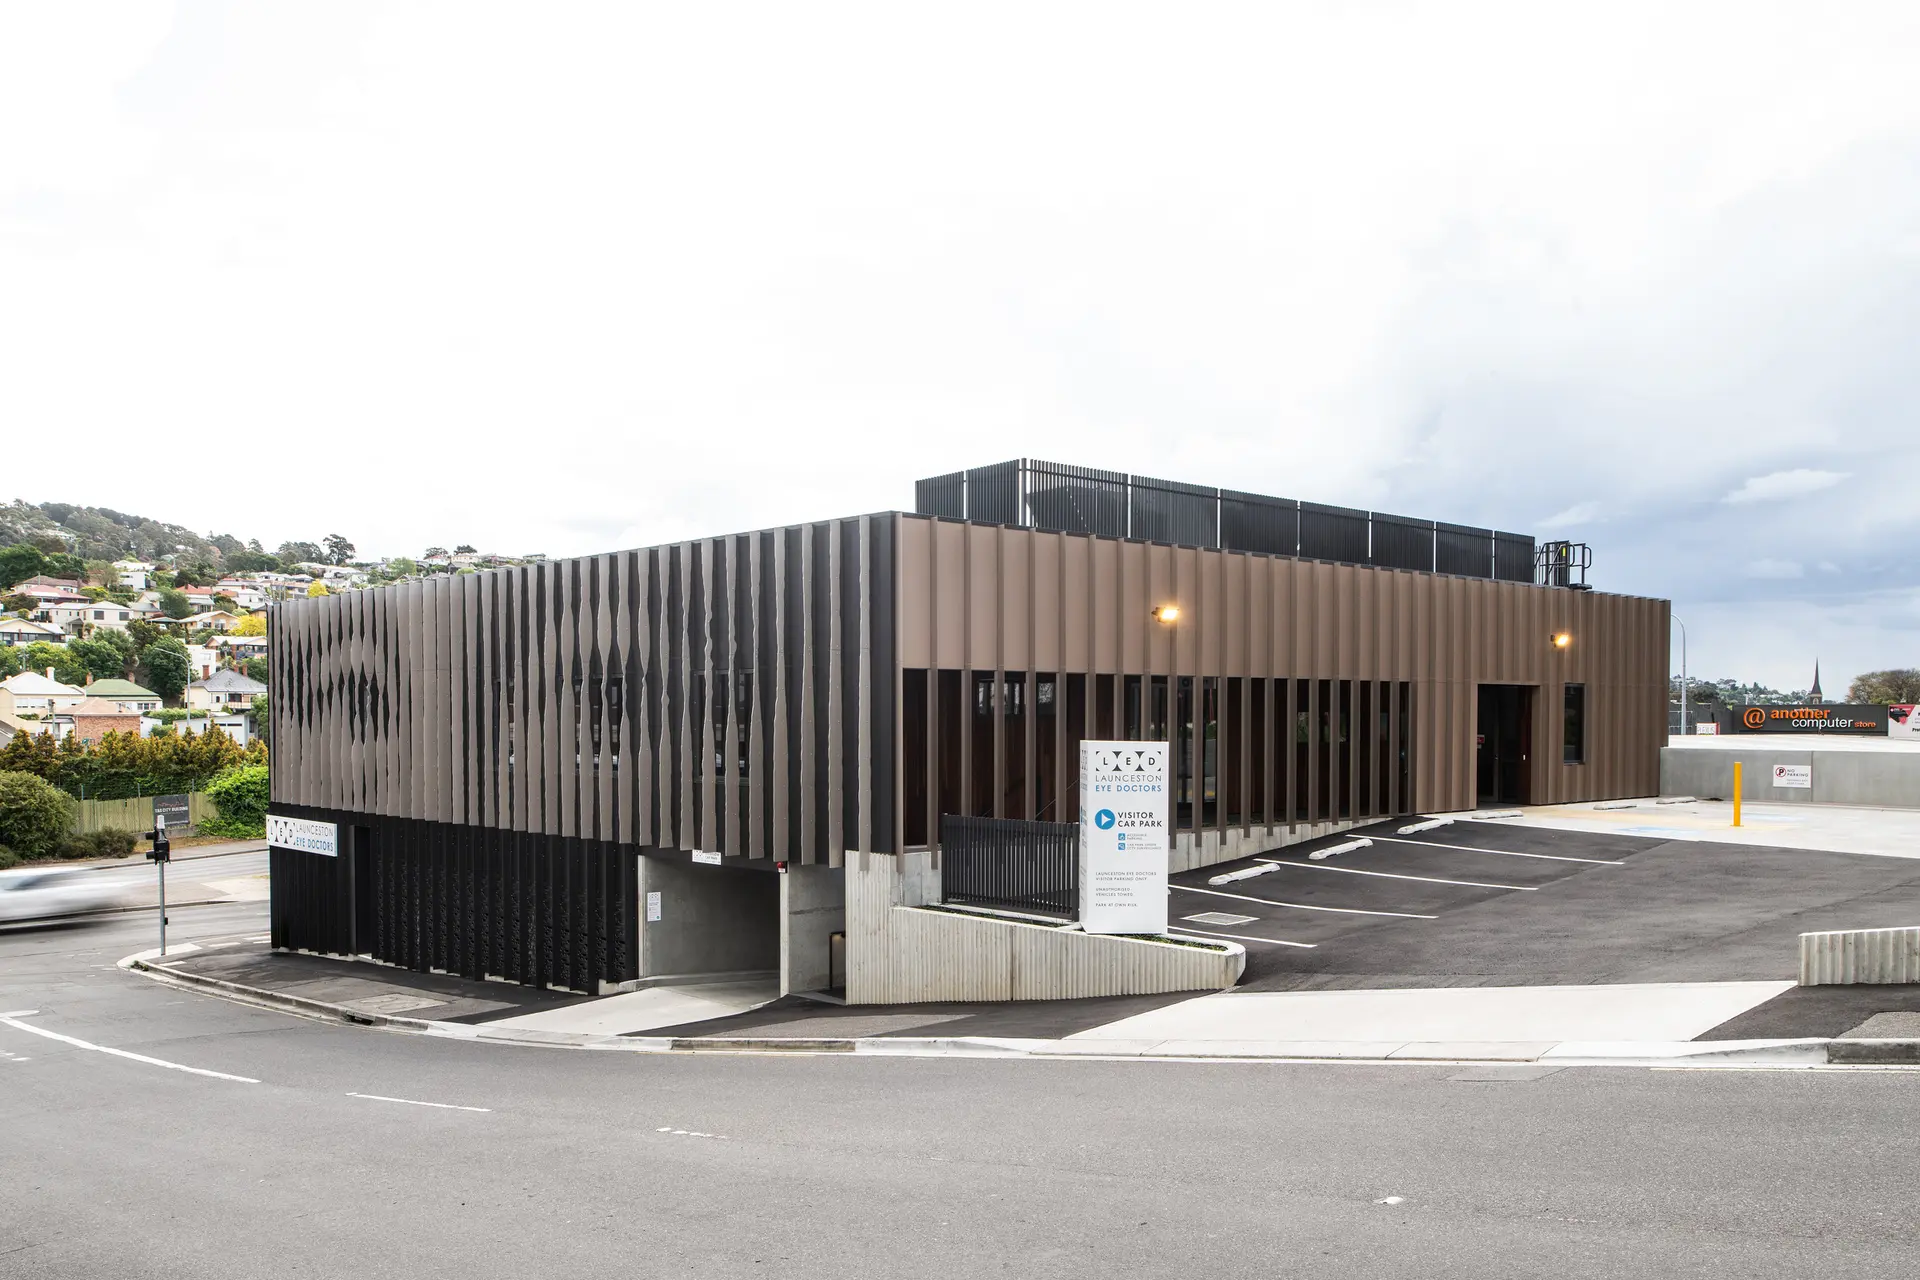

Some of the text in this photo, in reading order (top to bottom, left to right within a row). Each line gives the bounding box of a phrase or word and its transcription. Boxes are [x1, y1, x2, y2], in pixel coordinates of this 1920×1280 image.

[1770, 708, 1831, 719] another
[1792, 717, 1853, 730] computer
[1095, 774, 1162, 783] LAUNCESTON
[296, 823, 333, 836] LAUNCESTON
[296, 837, 333, 852] EYE DOCTORS
